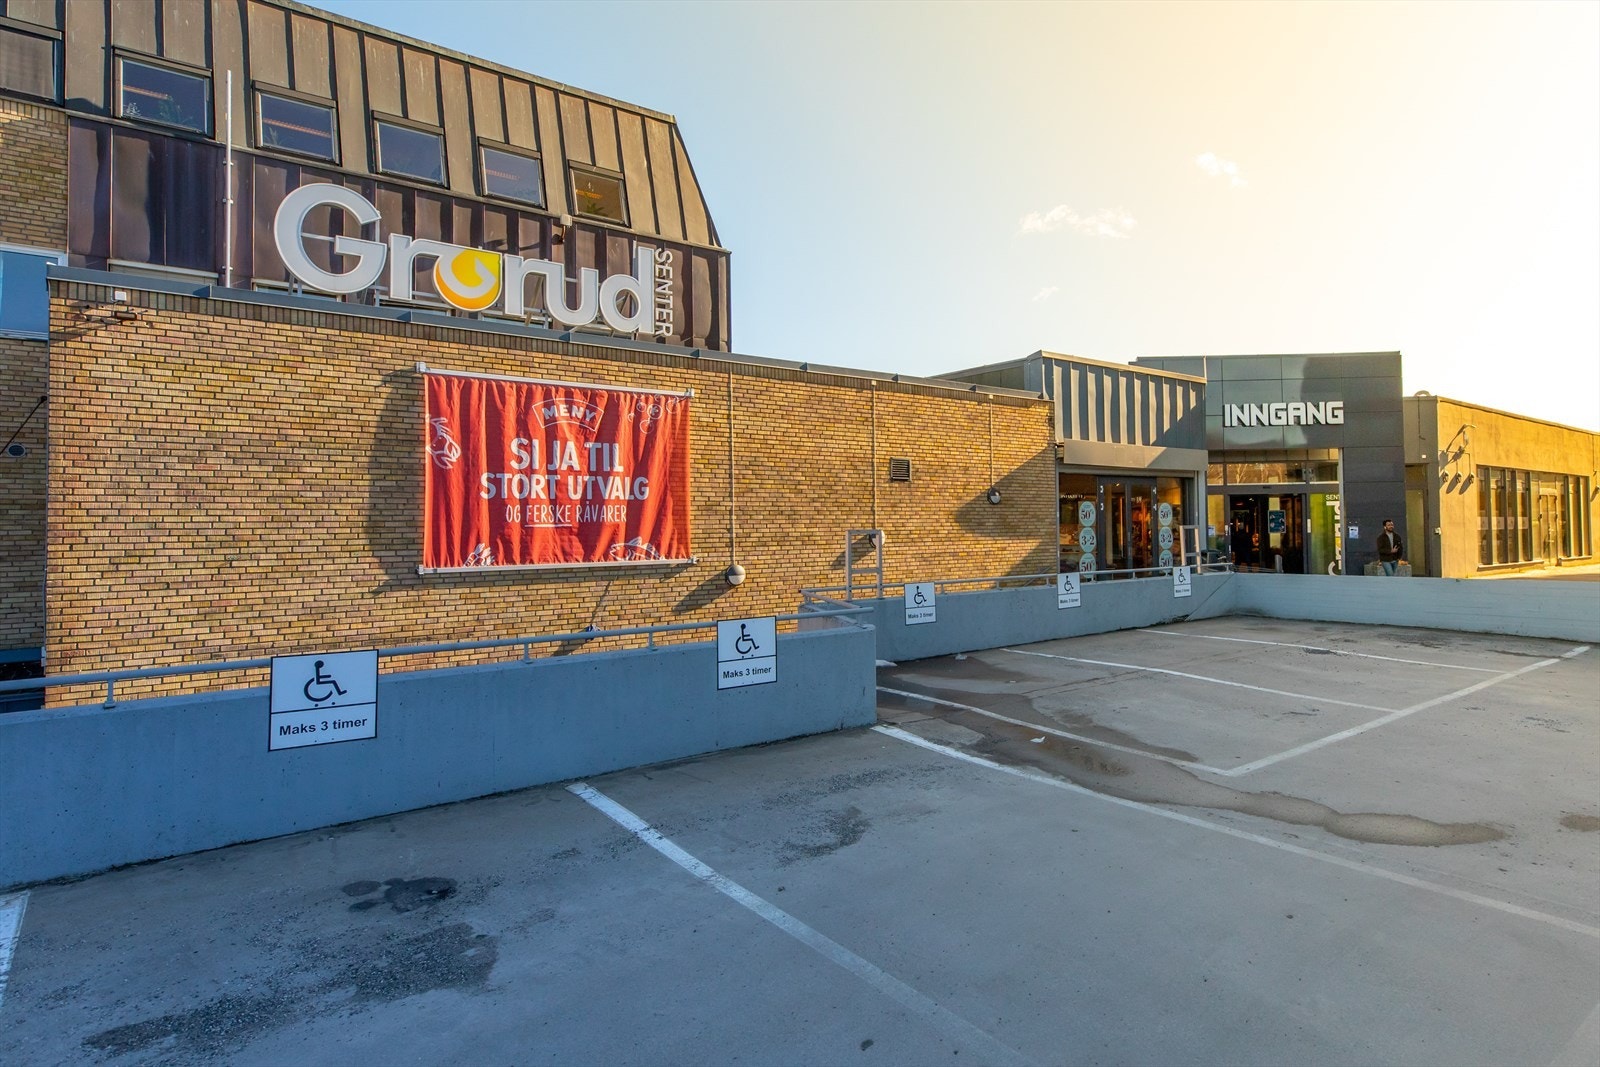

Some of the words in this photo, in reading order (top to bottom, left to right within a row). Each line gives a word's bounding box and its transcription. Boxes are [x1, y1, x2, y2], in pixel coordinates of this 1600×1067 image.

[274, 182, 655, 335] Grorud
[655, 247, 674, 338] SENTER
[541, 403, 597, 423] MENY
[1224, 401, 1345, 427] INNGANG
[510, 437, 540, 471] SI
[547, 440, 580, 472] JA
[584, 442, 624, 473] TIL
[480, 472, 560, 500] STORT
[567, 475, 650, 501] UTVALG
[505, 504, 521, 523] OG
[525, 504, 572, 523] FERSKE
[576, 501, 627, 523] RÅVARER
[722, 670, 743, 679] Maks
[745, 668, 751, 676] 3
[752, 666, 772, 675] timer
[279, 723, 316, 736] Maks
[320, 720, 329, 731] 3
[333, 718, 368, 730] timer
